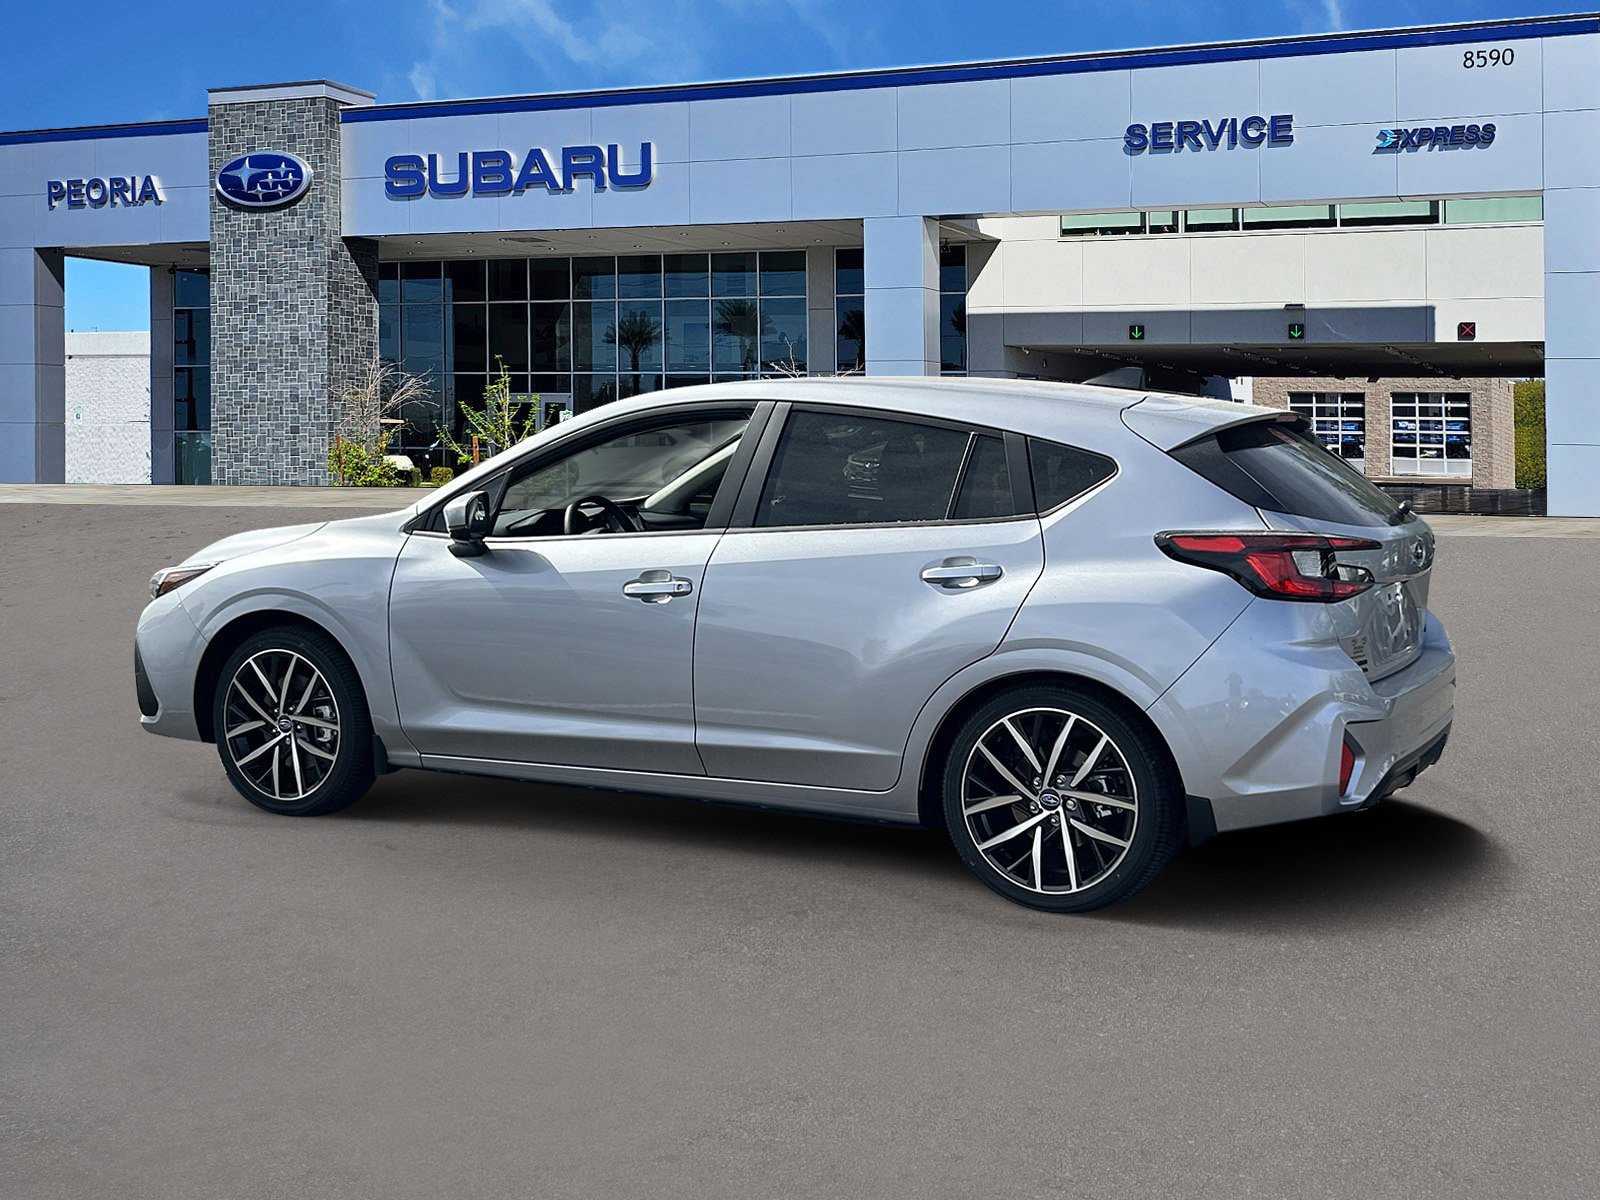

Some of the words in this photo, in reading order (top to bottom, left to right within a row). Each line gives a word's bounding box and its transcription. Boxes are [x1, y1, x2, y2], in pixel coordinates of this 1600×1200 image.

[1463, 48, 1514, 69] 8590
[1125, 114, 1294, 152] SERVICE
[1376, 123, 1497, 150] EXPRESS
[384, 142, 653, 199] SUBARU
[47, 175, 162, 209] PEORIA
